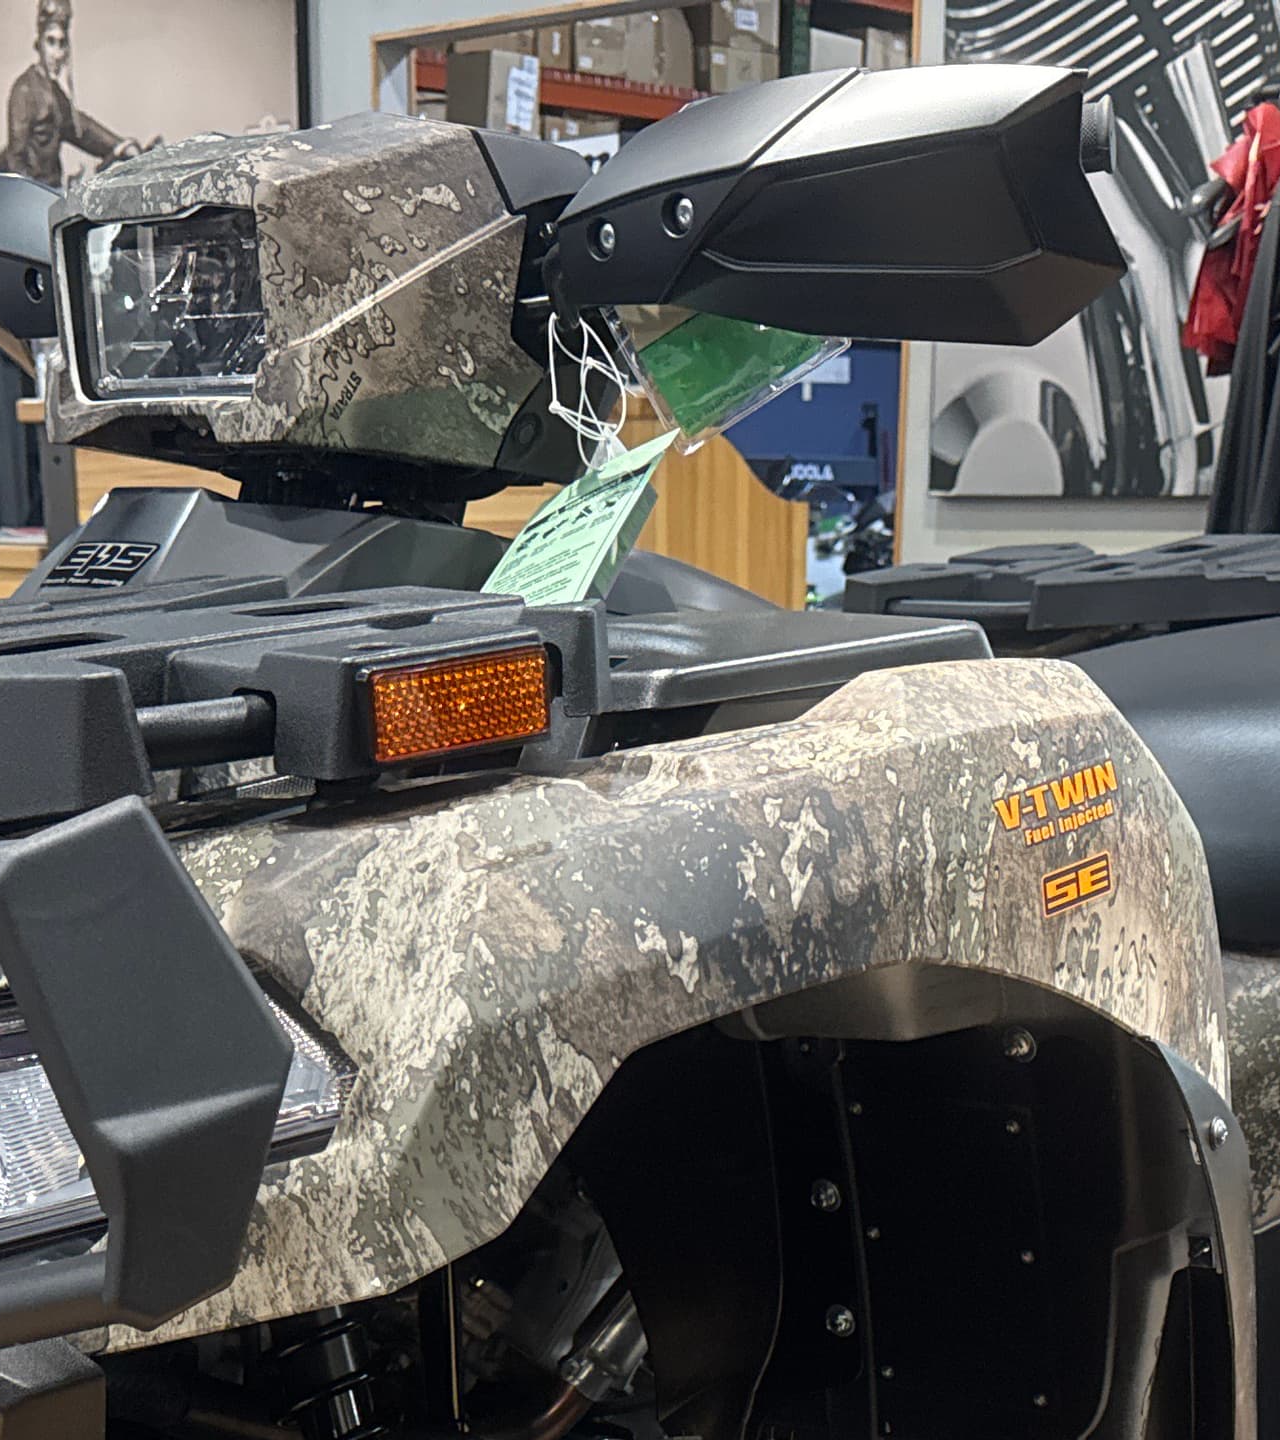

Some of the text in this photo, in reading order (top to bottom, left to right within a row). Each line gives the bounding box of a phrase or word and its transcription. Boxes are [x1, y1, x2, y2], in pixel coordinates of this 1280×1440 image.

[330, 371, 362, 420] STRATA
[56, 542, 157, 576] EPS
[994, 760, 1118, 830] V-TWIN
[1024, 798, 1114, 847] Fuel Injected
[1045, 859, 1110, 911] SE
